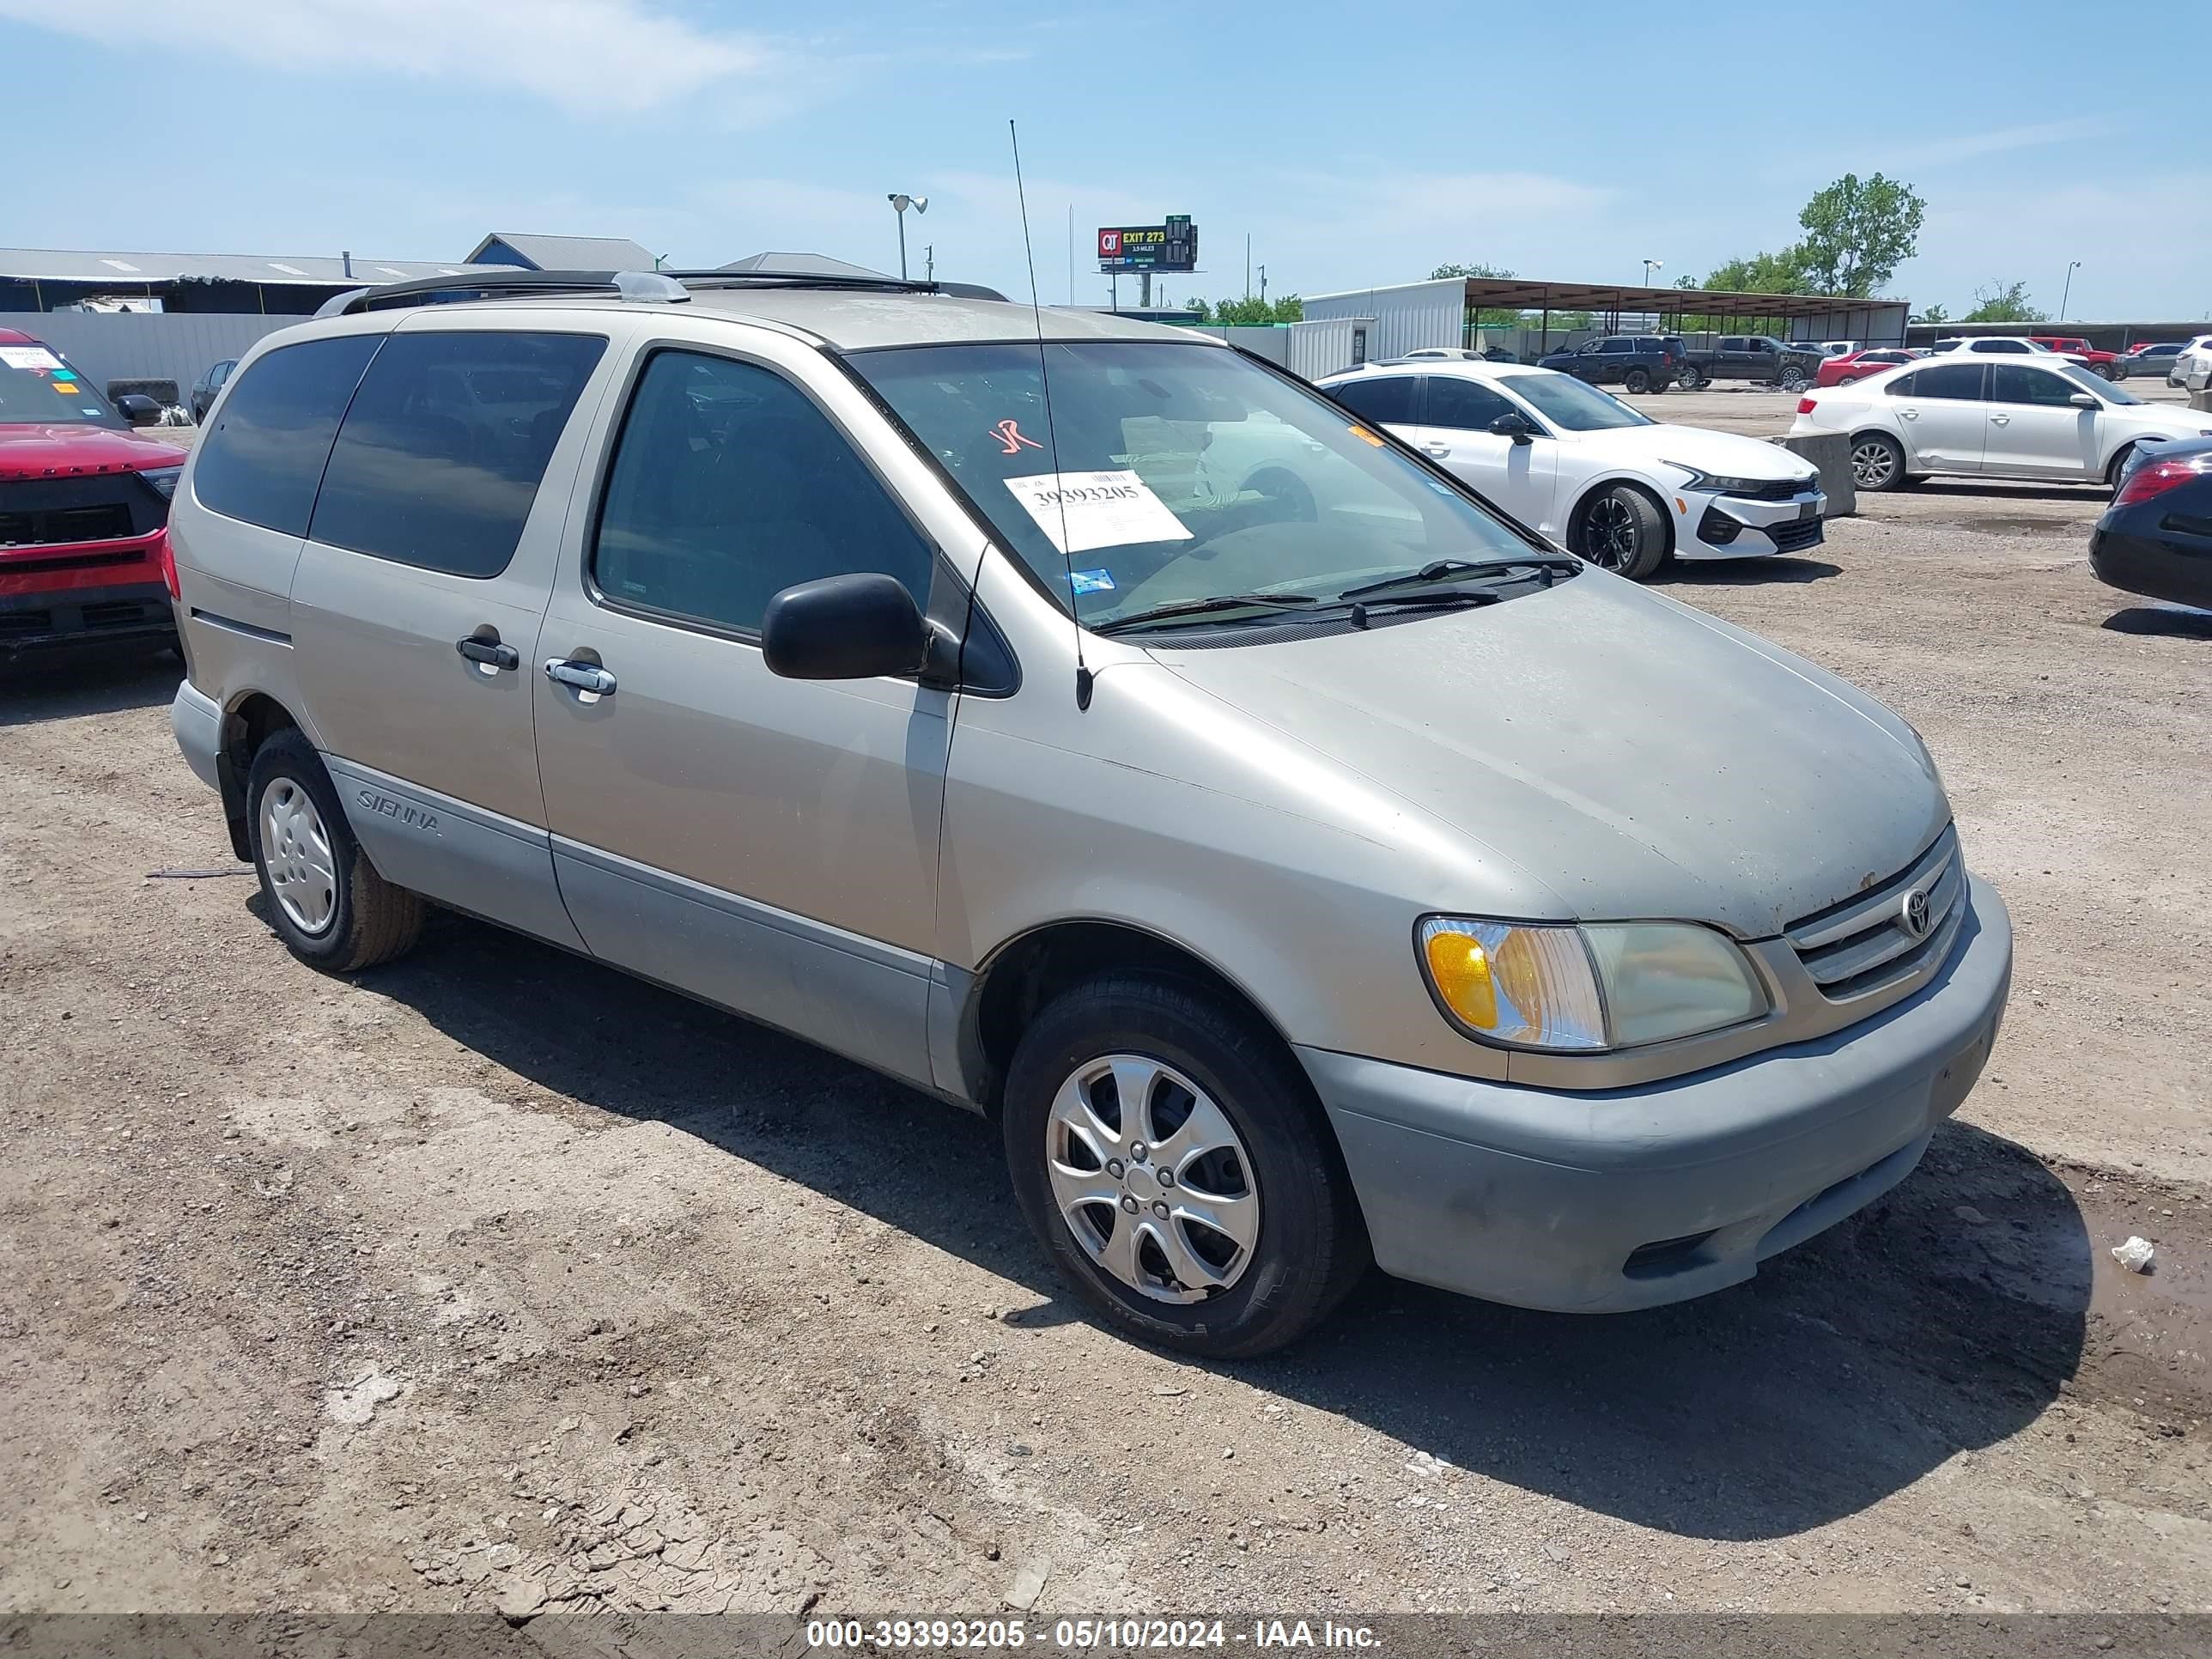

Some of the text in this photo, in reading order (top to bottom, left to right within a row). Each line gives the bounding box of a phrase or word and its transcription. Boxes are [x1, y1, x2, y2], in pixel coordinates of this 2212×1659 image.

[1102, 234, 1118, 251] QT
[1122, 233, 1145, 243] EXIT
[1146, 231, 1165, 243] 273
[1033, 485, 1139, 507] 39393205
[356, 789, 443, 837] SIENNA
